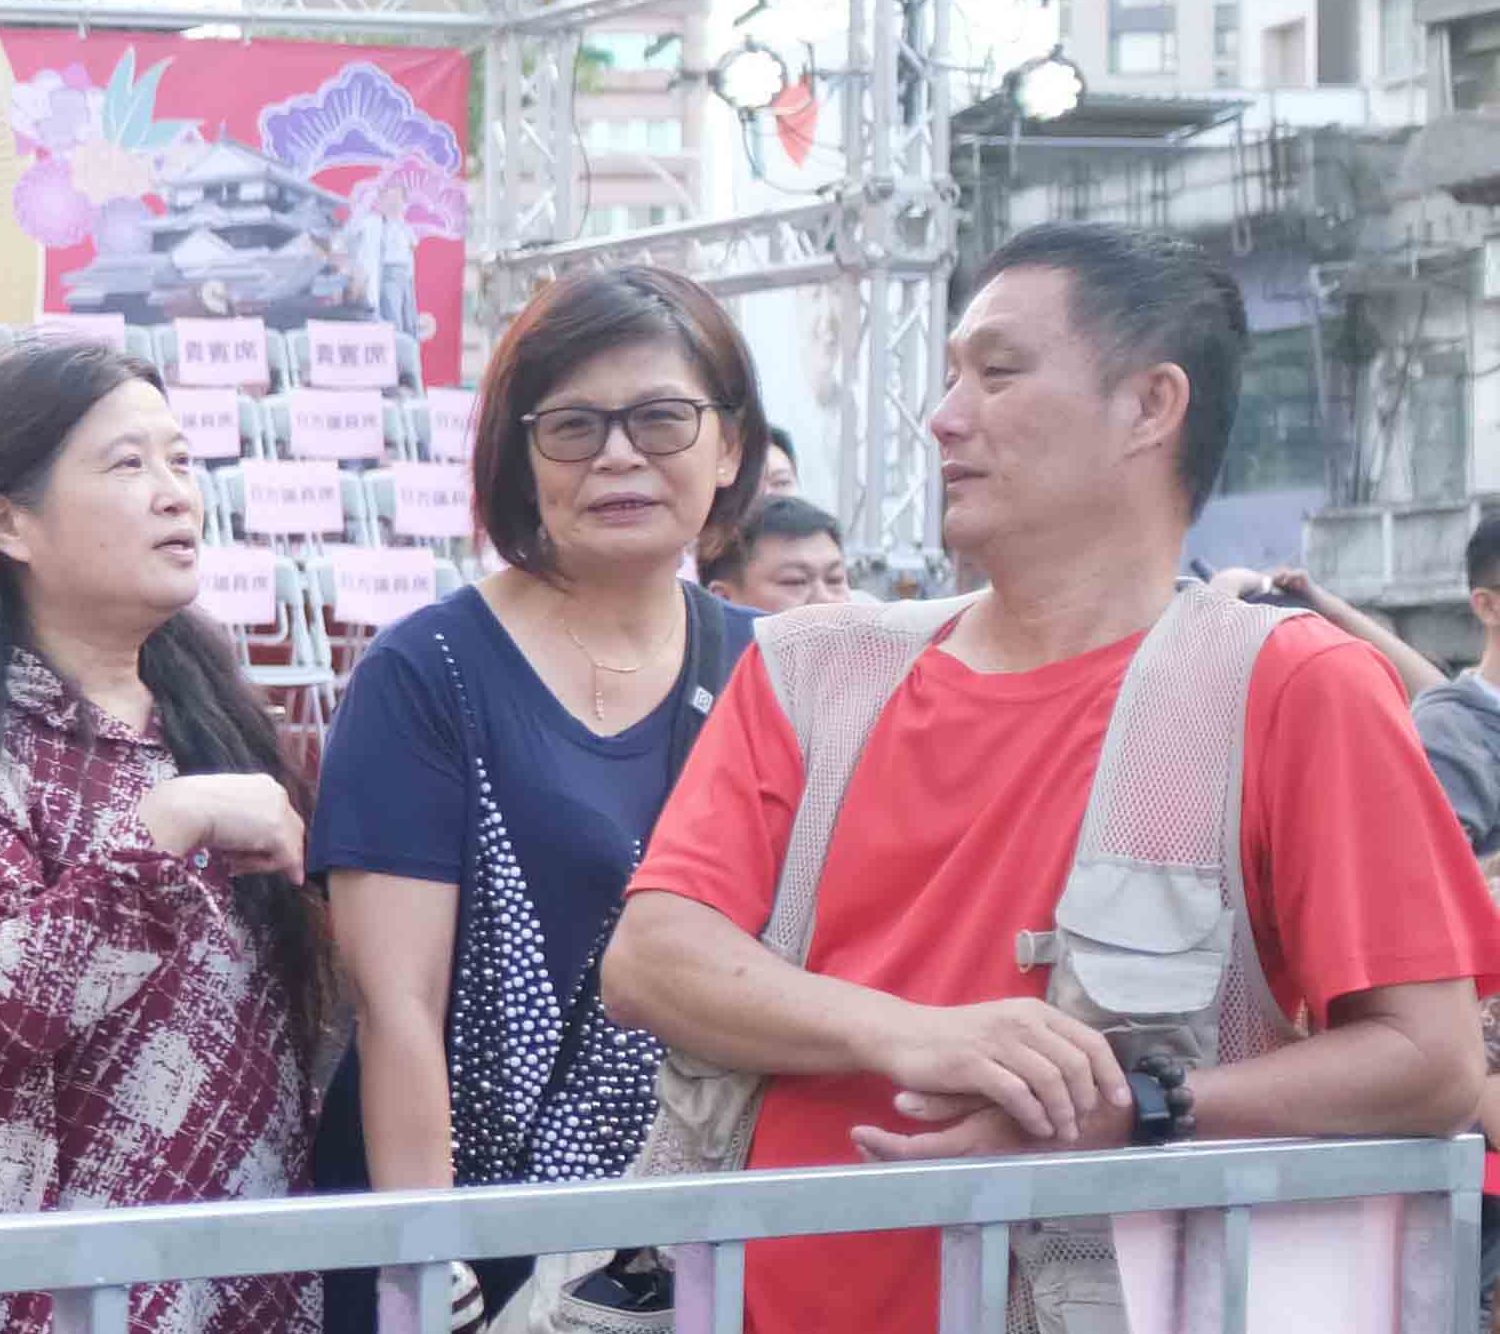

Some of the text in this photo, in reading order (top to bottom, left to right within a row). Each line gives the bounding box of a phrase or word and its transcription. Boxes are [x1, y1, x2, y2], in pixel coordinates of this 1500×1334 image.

[184, 340, 260, 363] 貴賓席
[315, 343, 388, 366] 貴賓席
